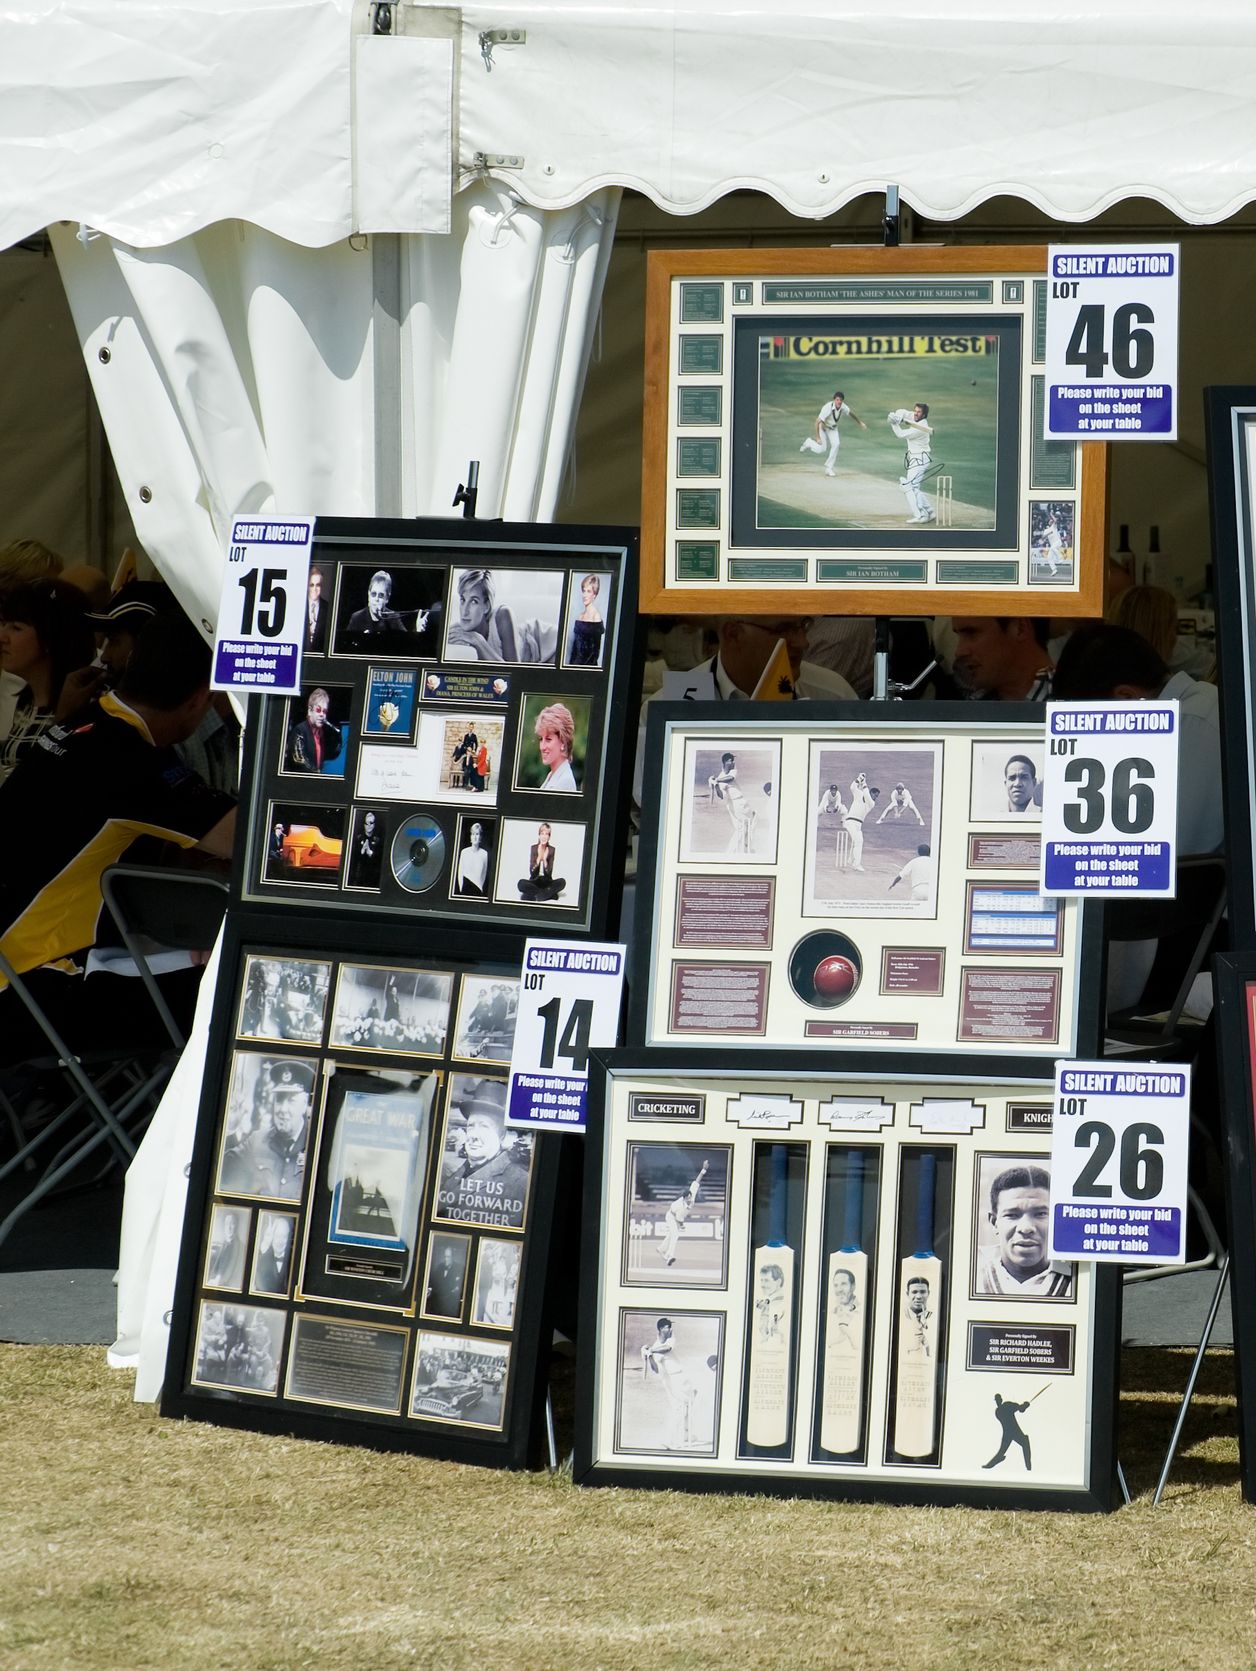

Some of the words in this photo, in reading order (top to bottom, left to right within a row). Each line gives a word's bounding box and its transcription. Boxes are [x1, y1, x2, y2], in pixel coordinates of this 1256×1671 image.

[1057, 258, 1105, 275] SILENT
[1107, 257, 1169, 274] AUCTION
[1053, 282, 1079, 298] LOT
[921, 336, 982, 354] Test
[1066, 303, 1155, 379] 46
[1058, 387, 1092, 399] Please
[1094, 387, 1119, 399] write
[1121, 388, 1144, 399] your
[1147, 387, 1163, 398] bid
[1079, 403, 1092, 414] on
[1093, 403, 1110, 414] the
[1113, 403, 1141, 414] sheet
[1078, 419, 1089, 429] at
[1091, 420, 1114, 430] your
[1115, 418, 1141, 429] table
[235, 525, 265, 541] SILENT
[265, 526, 307, 541] AUCTION
[229, 547, 246, 562] LOT
[239, 568, 287, 637] 15
[373, 671, 393, 682] ELTON
[396, 672, 413, 682] JOHN
[1055, 714, 1103, 731] SILENT
[1105, 713, 1169, 730] AUCTION
[1050, 739, 1077, 755] LOT
[1064, 758, 1155, 834] 36
[1054, 844, 1089, 855] Please
[1091, 845, 1117, 855] write
[1119, 846, 1142, 856] your
[1144, 844, 1161, 855] bid
[1075, 860, 1088, 871] on
[1090, 860, 1107, 871] the
[1109, 859, 1138, 871] sheet
[1075, 876, 1085, 886] at
[1087, 877, 1110, 887] your
[1112, 875, 1138, 886] table
[530, 950, 566, 968] SILENT
[567, 953, 617, 971] AUCTION
[524, 973, 545, 990] LOT
[537, 997, 594, 1071] 14
[1064, 1073, 1114, 1091] SILENT
[1116, 1074, 1180, 1093] AUCTION
[638, 1103, 696, 1114] CRICKETING
[1060, 1098, 1087, 1115] LOT
[346, 1107, 384, 1124] GREAT
[387, 1112, 416, 1128] WAR
[1024, 1113, 1052, 1123] KNIGH
[1073, 1121, 1164, 1200] 26
[486, 1181, 504, 1195] US
[439, 1191, 455, 1202] GO
[458, 1194, 522, 1212] FORWARD
[1062, 1206, 1098, 1218] Please
[1100, 1207, 1127, 1219] write
[1129, 1209, 1152, 1221] your
[1154, 1209, 1171, 1221] bid
[1084, 1224, 1098, 1234] on
[1100, 1223, 1117, 1235] the
[1119, 1224, 1148, 1236] sheet
[1083, 1240, 1094, 1250] at
[1096, 1241, 1120, 1251] your
[1121, 1240, 1148, 1251] table
